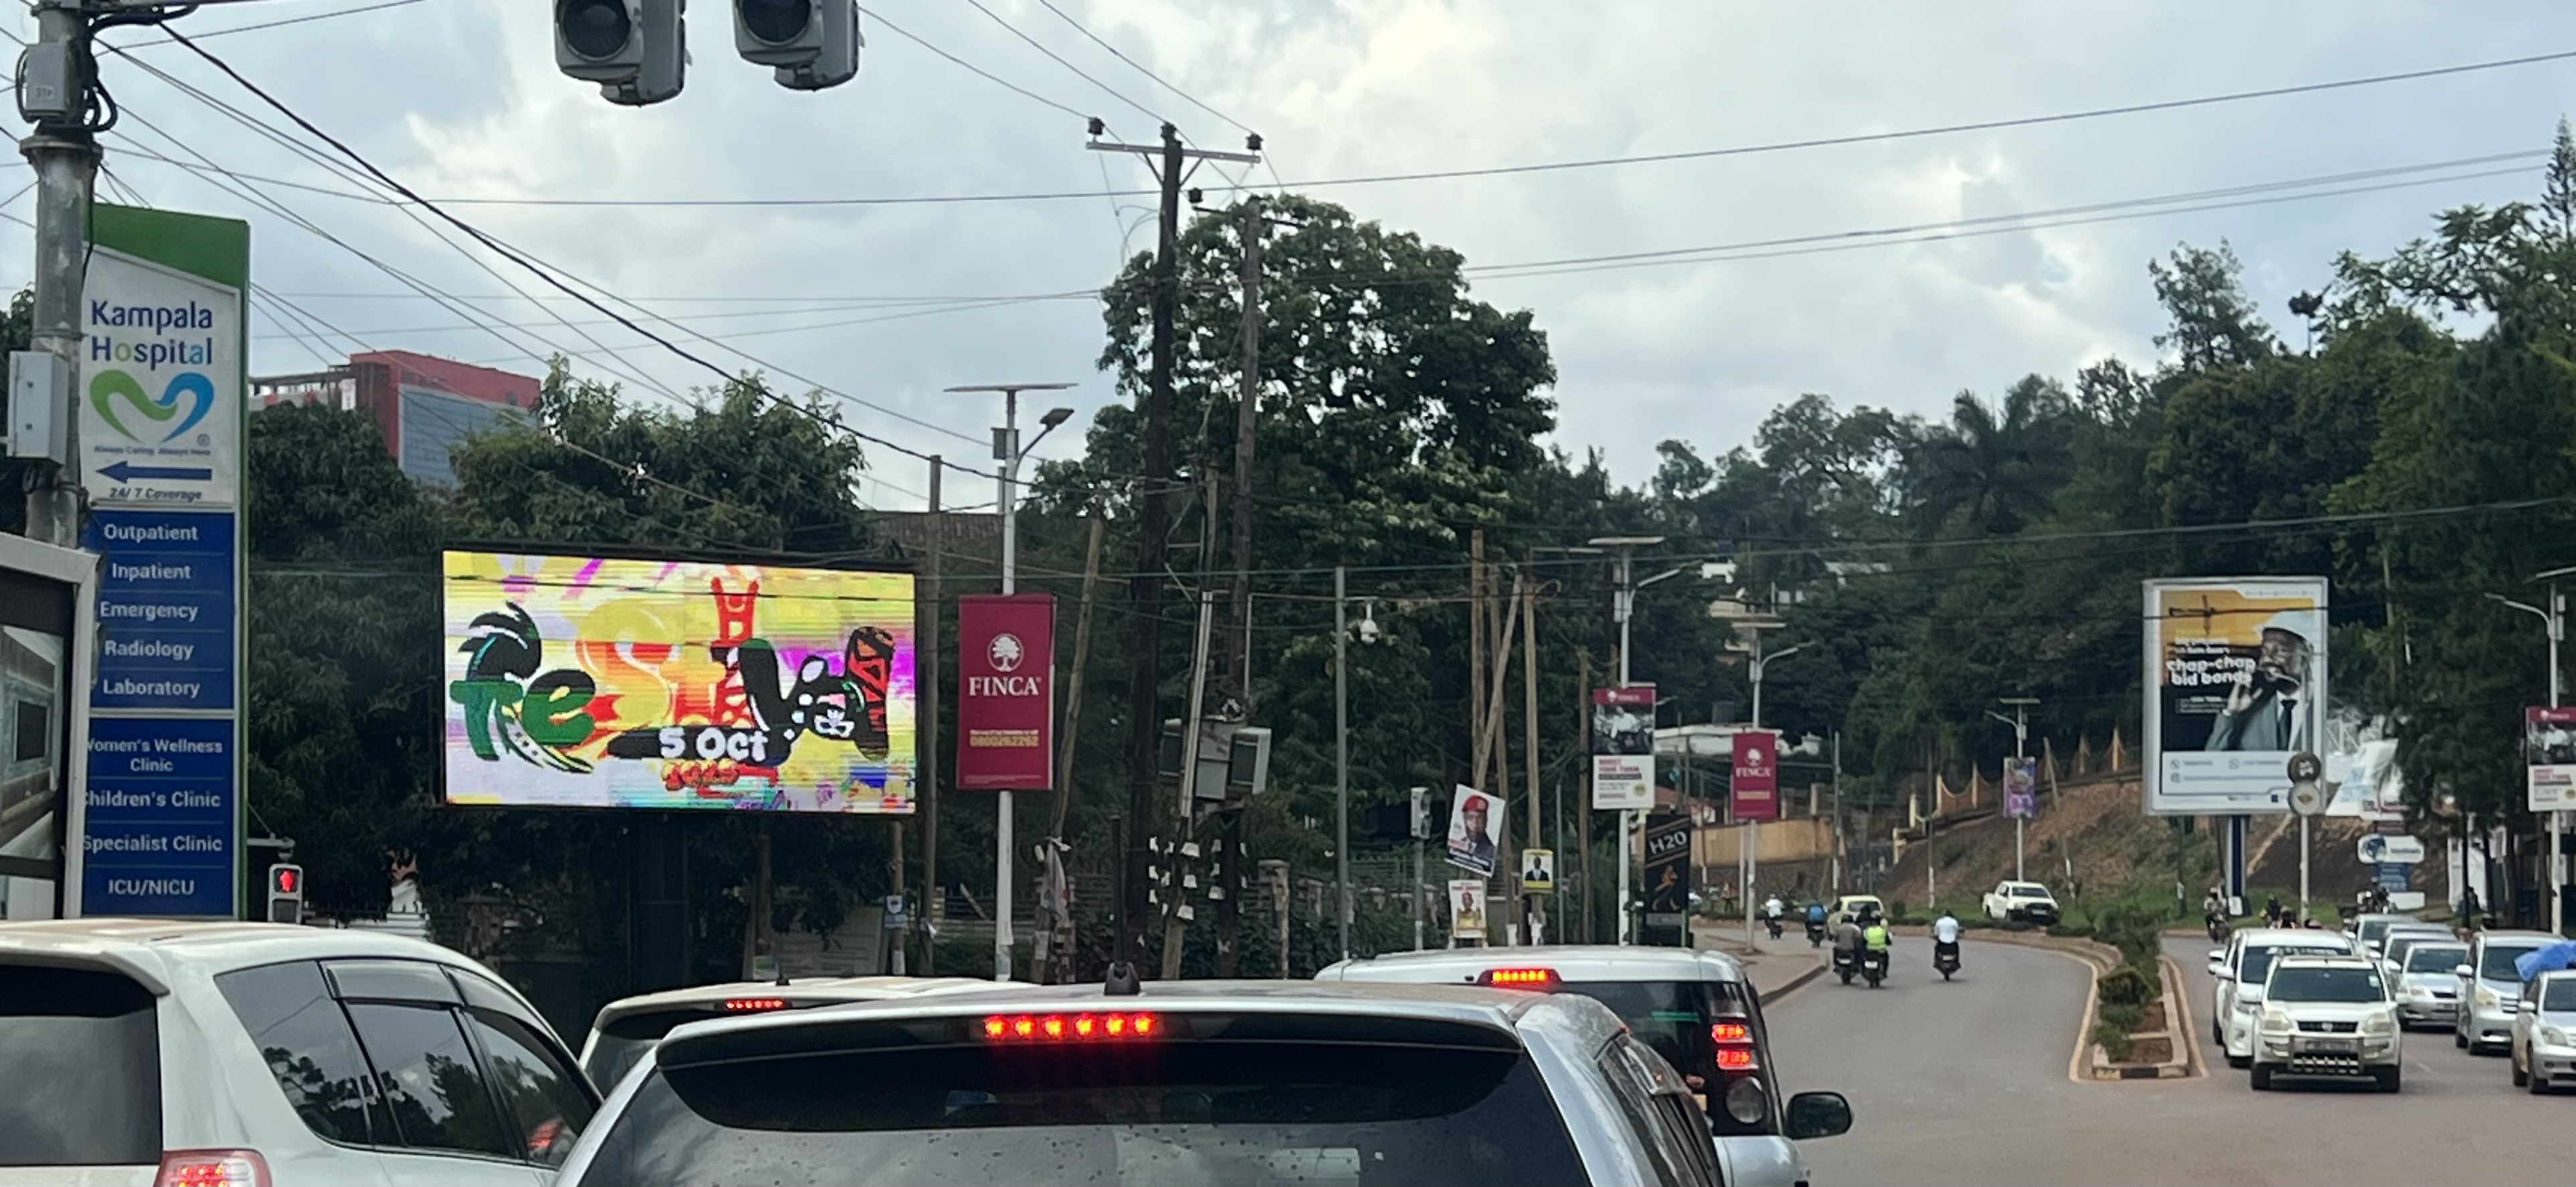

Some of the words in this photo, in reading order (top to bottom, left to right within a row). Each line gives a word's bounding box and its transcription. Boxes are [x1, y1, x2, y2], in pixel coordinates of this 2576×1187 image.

[92, 301, 213, 334] Kampala
[92, 336, 213, 370] Hospital
[145, 488, 202, 502] Coverage
[104, 524, 198, 543] Outpatient
[112, 562, 191, 582] Inpatient
[100, 601, 199, 622] Emergency
[105, 640, 195, 661] Radiology
[2165, 655, 2256, 674] chap-chap
[969, 676, 1039, 696] FINCA
[2171, 669, 2198, 686] bid
[103, 678, 200, 698] Laboratory
[153, 738, 223, 753] Wellness
[659, 727, 686, 759] 5
[695, 727, 768, 762] Oct
[130, 757, 174, 772] Clinic
[85, 790, 167, 807] hildren's
[171, 790, 221, 807] Clinic
[83, 834, 168, 854] Specialist
[173, 835, 223, 851] Clinic
[108, 879, 195, 896] ICU/NICU
